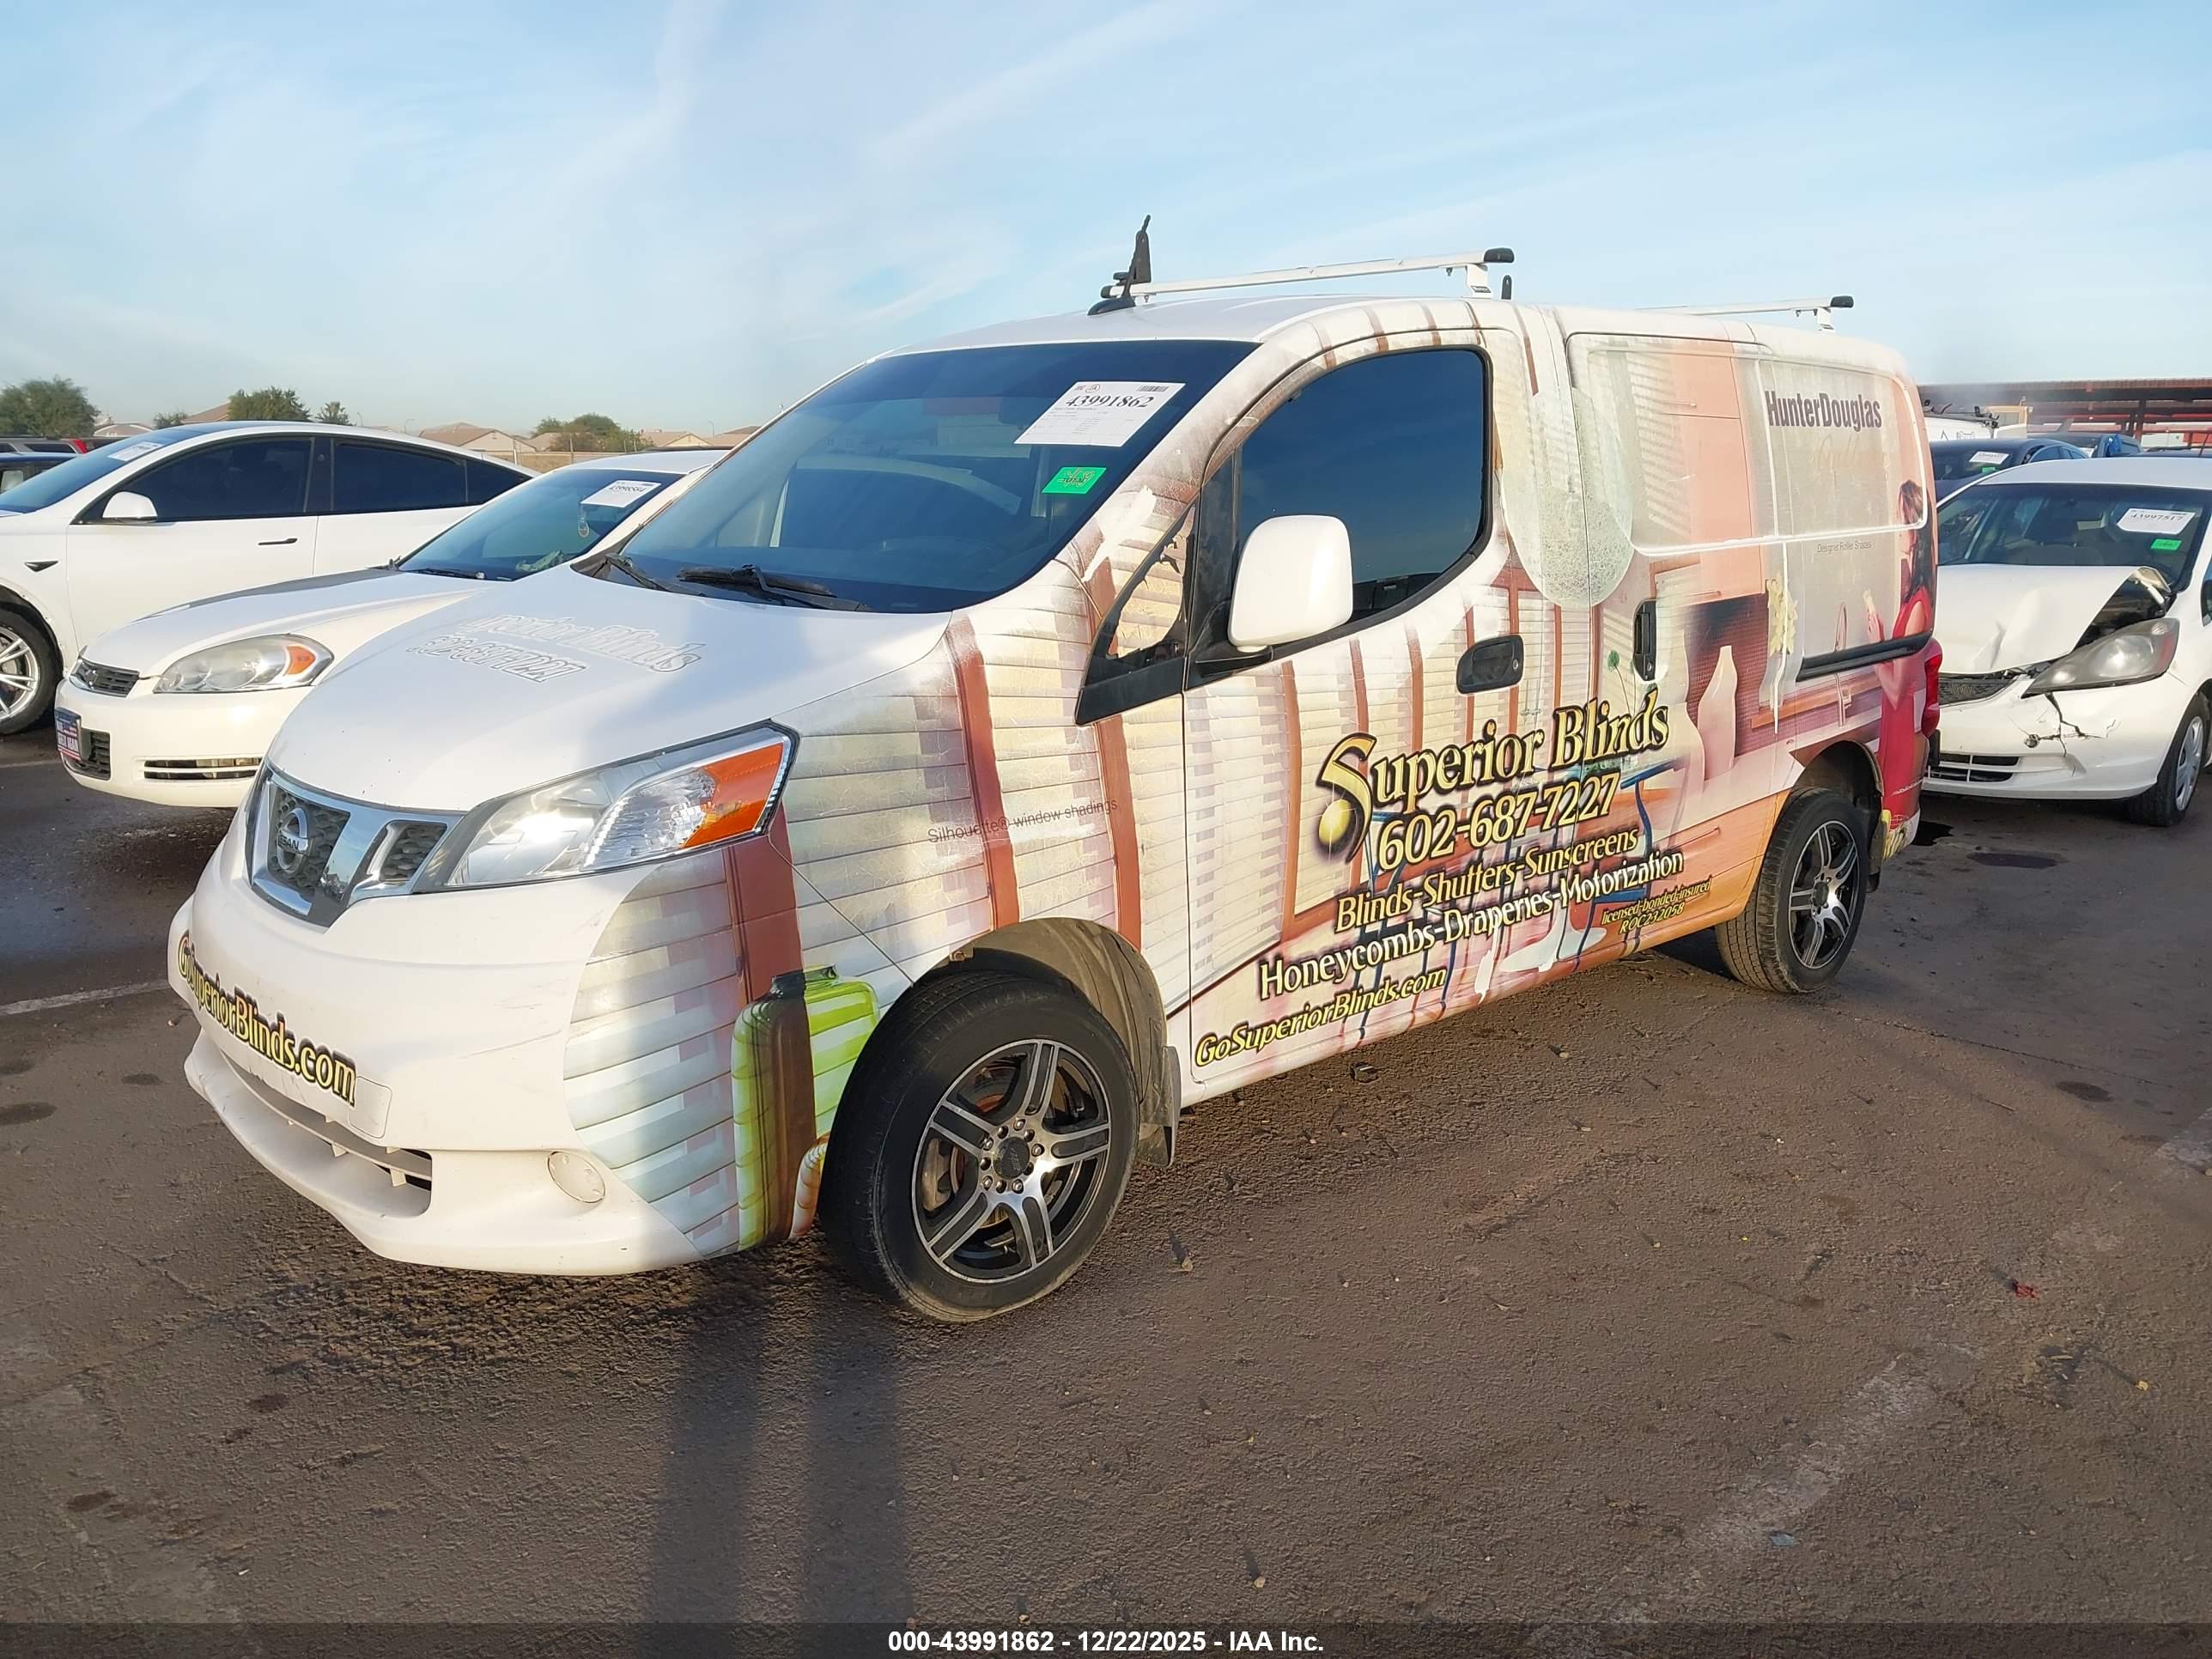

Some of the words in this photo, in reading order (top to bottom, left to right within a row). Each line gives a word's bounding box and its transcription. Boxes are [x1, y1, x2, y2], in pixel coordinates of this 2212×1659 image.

[1066, 395, 1154, 408] 43991862
[1765, 390, 1882, 432] HunterDouglas
[1013, 811, 1061, 828] window
[1065, 798, 1118, 818] shadings
[1317, 720, 1545, 862] Superior
[1551, 688, 1670, 771] Blinds
[1376, 771, 1621, 871] 602-687-7227
[1259, 852, 1686, 1001] Honeycombs-Draperies-Motorization
[1336, 828, 1639, 934] Blinds-Shutters-Sunscreens
[1620, 902, 1685, 934] ROC232058
[1195, 966, 1447, 1068] GoSuperiorBlinds.com
